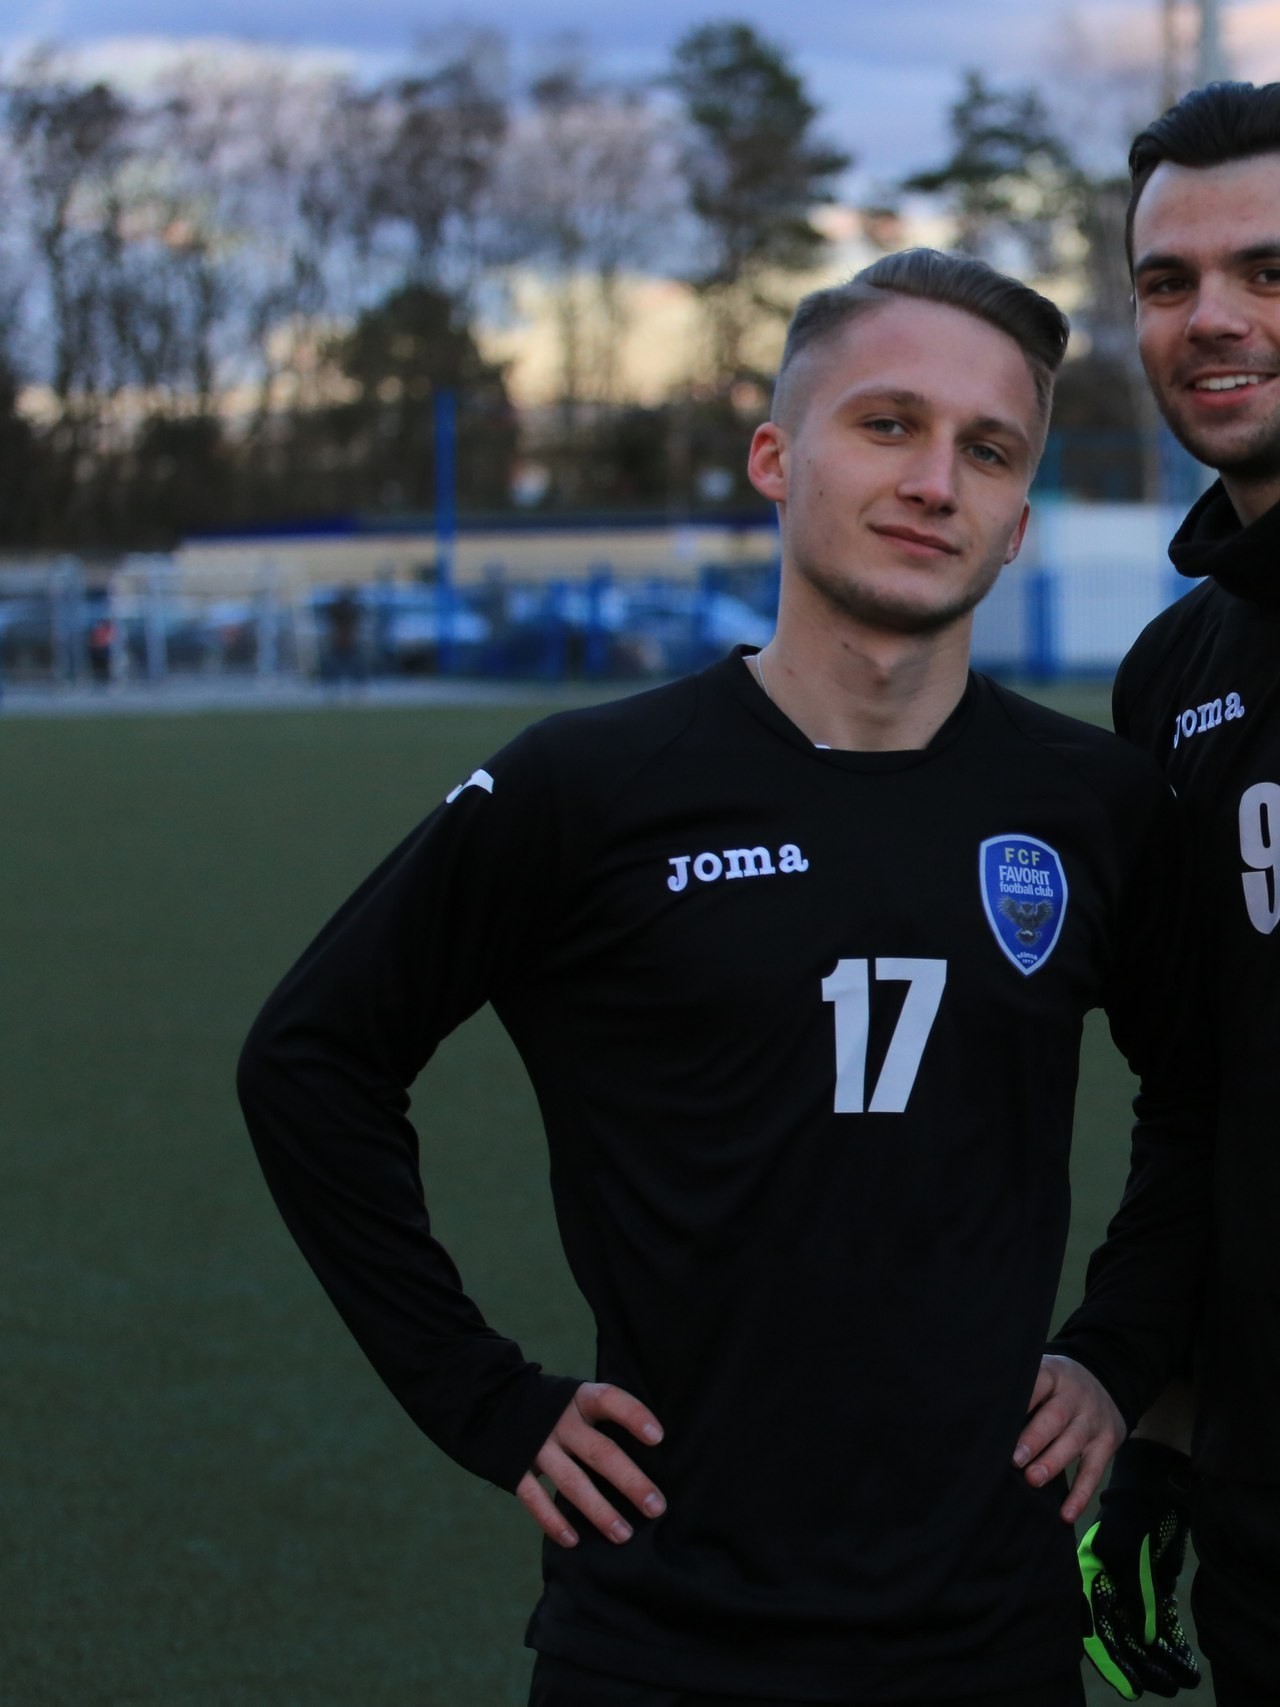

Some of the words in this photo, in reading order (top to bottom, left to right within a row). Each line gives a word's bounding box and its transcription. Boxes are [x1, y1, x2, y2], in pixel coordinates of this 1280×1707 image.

[1005, 847, 1041, 866] FCF
[999, 865, 1050, 885] FAVORIT
[1000, 881, 1034, 895] football
[1034, 886, 1054, 897] club
[821, 957, 947, 1113] 17
